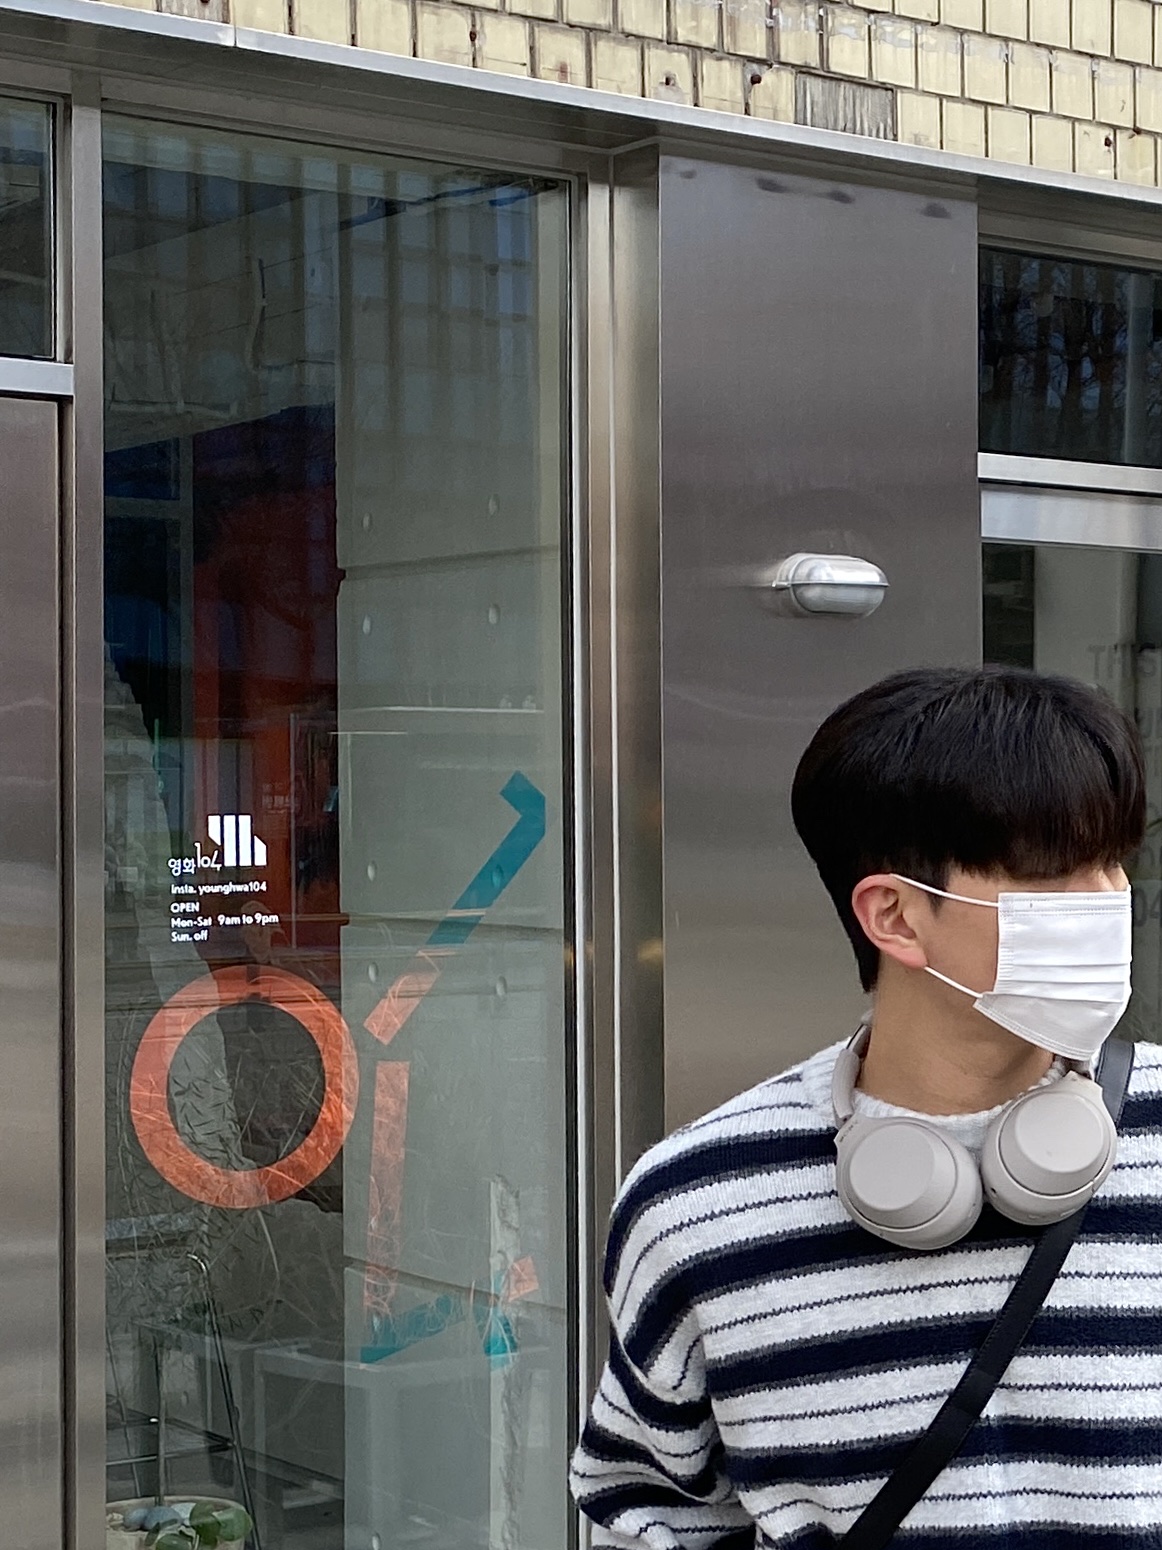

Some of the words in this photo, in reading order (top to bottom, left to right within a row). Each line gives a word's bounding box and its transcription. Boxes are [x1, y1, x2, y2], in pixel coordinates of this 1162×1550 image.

[170, 901, 200, 914] OPEN
[171, 916, 212, 929] Mon-Sat
[193, 929, 208, 941] off
